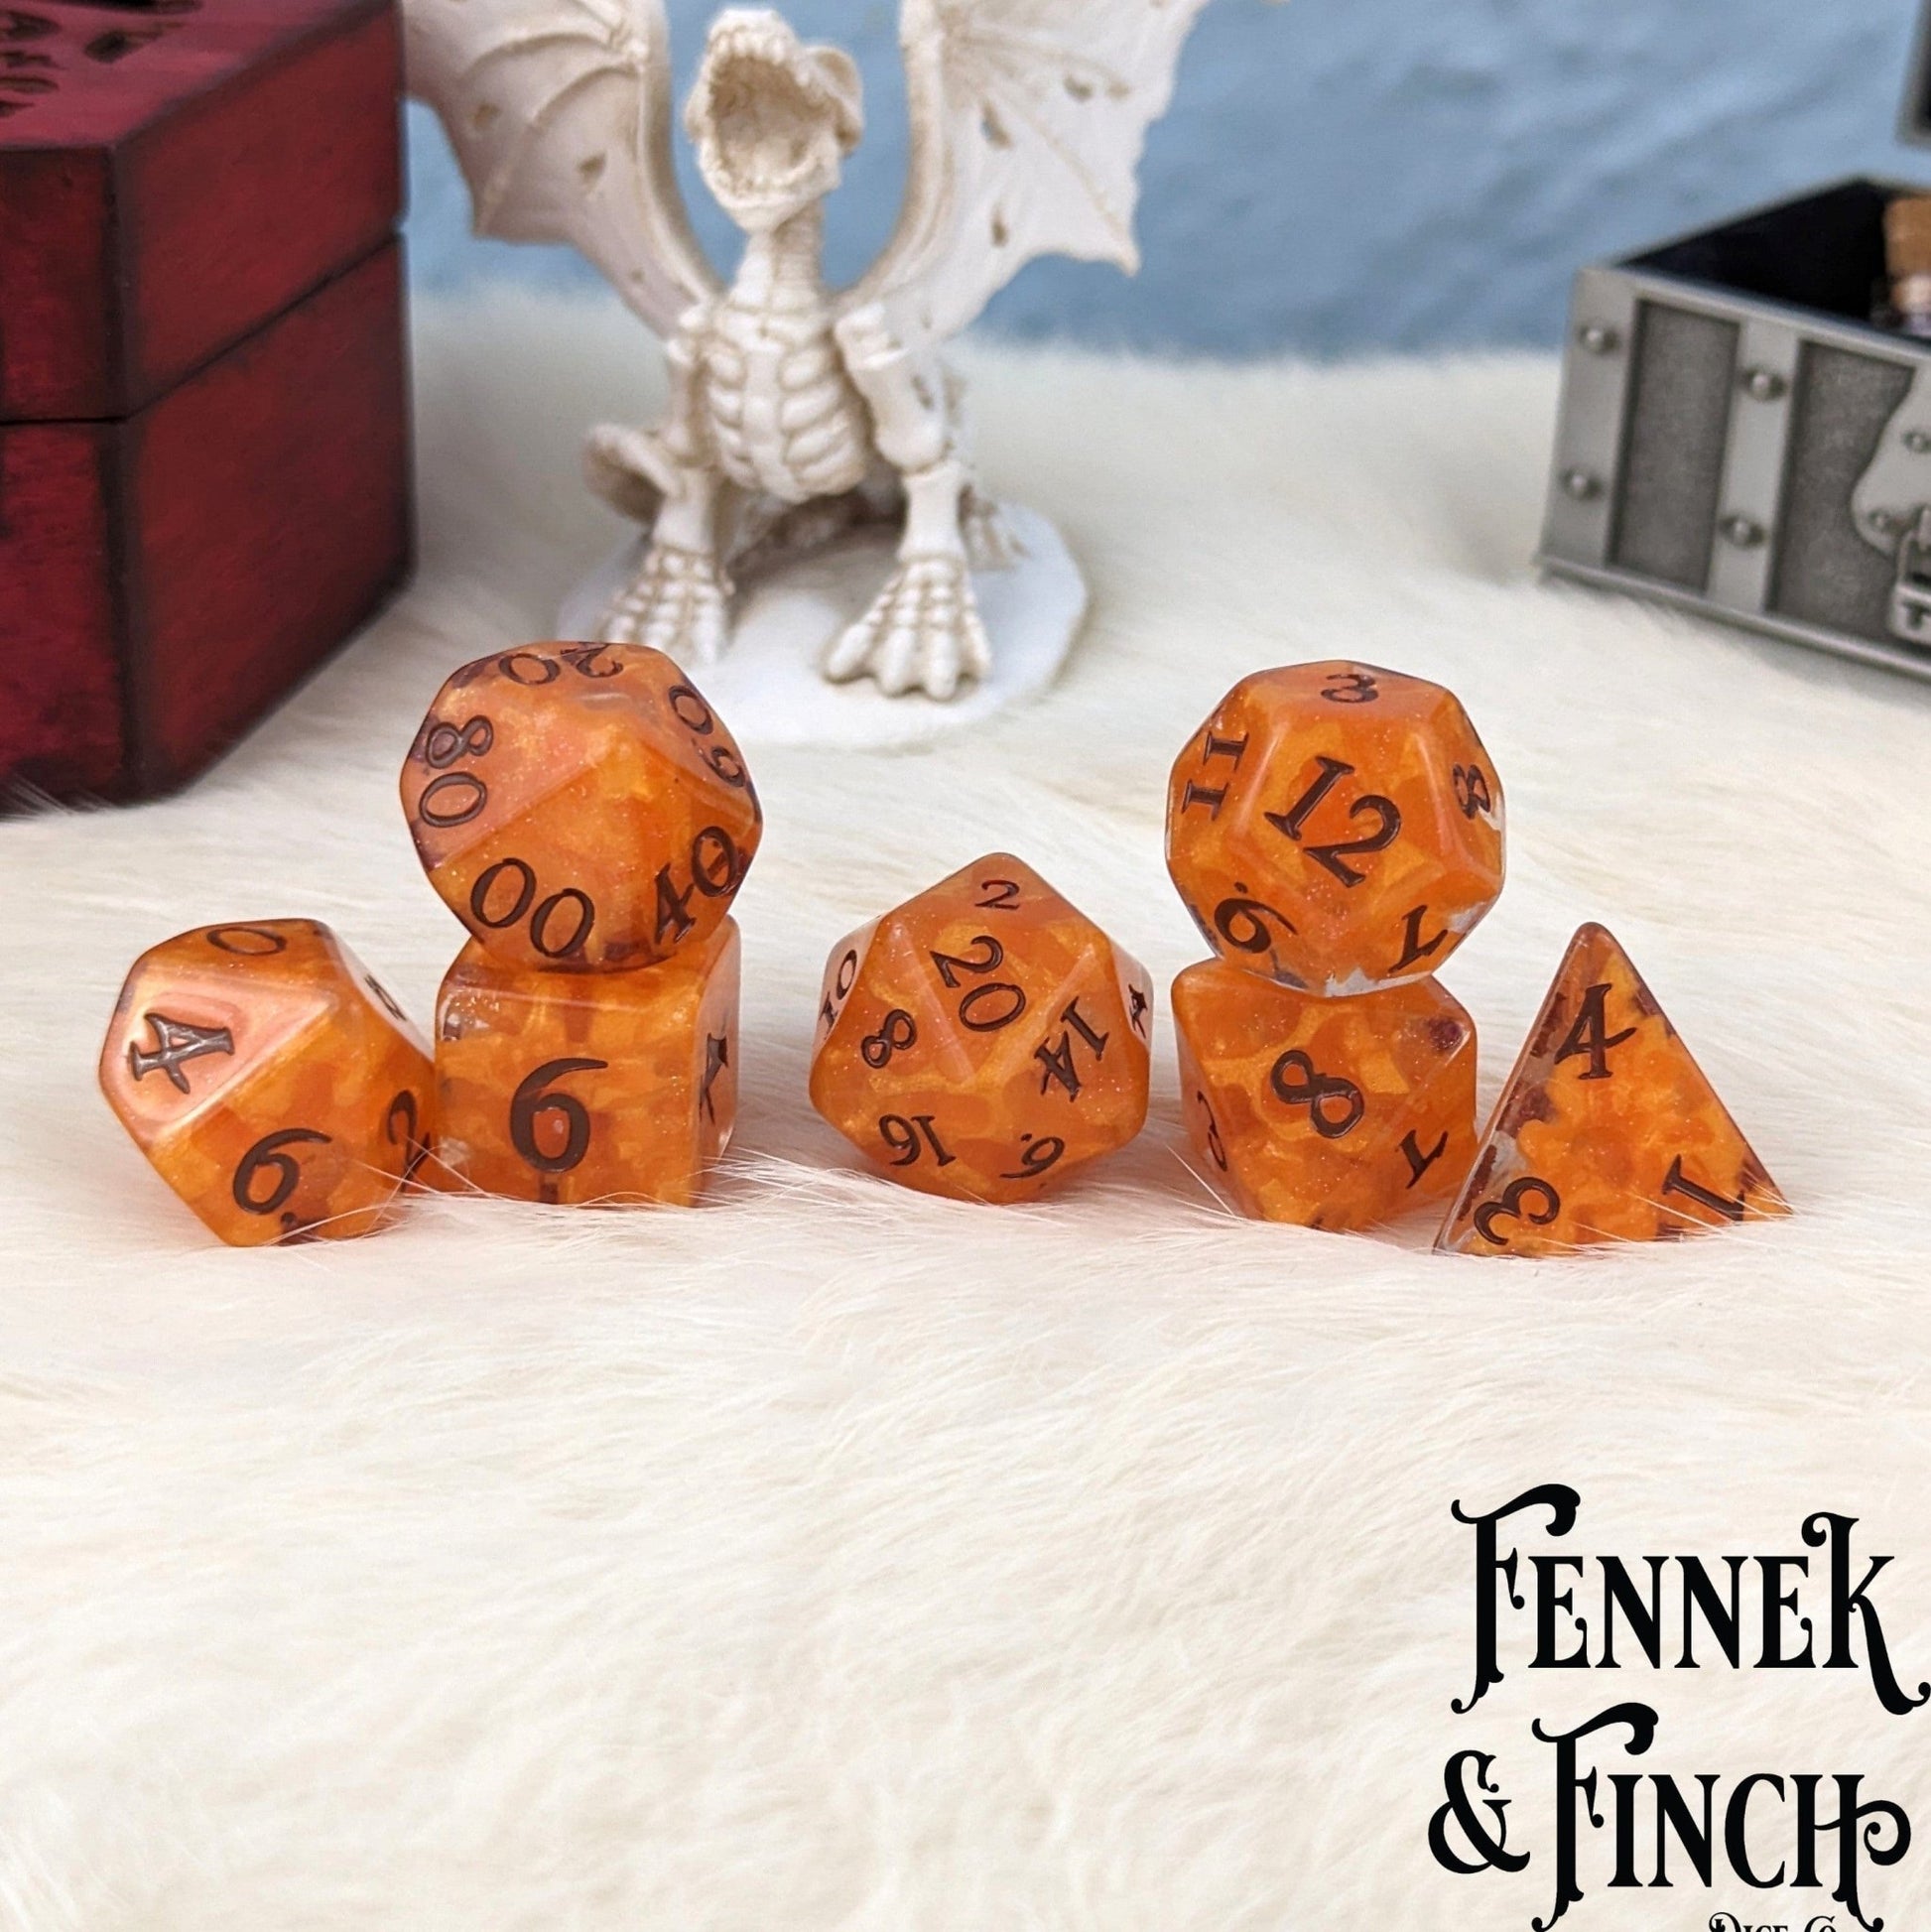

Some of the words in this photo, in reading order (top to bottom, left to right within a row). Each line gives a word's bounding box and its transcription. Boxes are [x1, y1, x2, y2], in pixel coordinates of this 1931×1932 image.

[499, 642, 623, 685] 20
[1321, 674, 1378, 703] 3
[419, 714, 494, 828] 80
[1182, 730, 1249, 821] 11
[1264, 755, 1401, 888] 12
[470, 857, 595, 959] 00
[655, 826, 738, 945] 40
[975, 879, 1021, 910] 2
[206, 926, 288, 956] 0
[930, 935, 1026, 1032] 20
[129, 1012, 235, 1095] 4
[861, 1008, 917, 1070] 8
[1034, 996, 1110, 1102] 14
[1554, 982, 1637, 1080] 4
[510, 1058, 609, 1173] 6
[1270, 1049, 1365, 1139] 8
[387, 1090, 432, 1193] 2
[878, 1113, 957, 1167] 16
[1474, 1176, 1561, 1246] 3
[1662, 1153, 1745, 1222] 1
